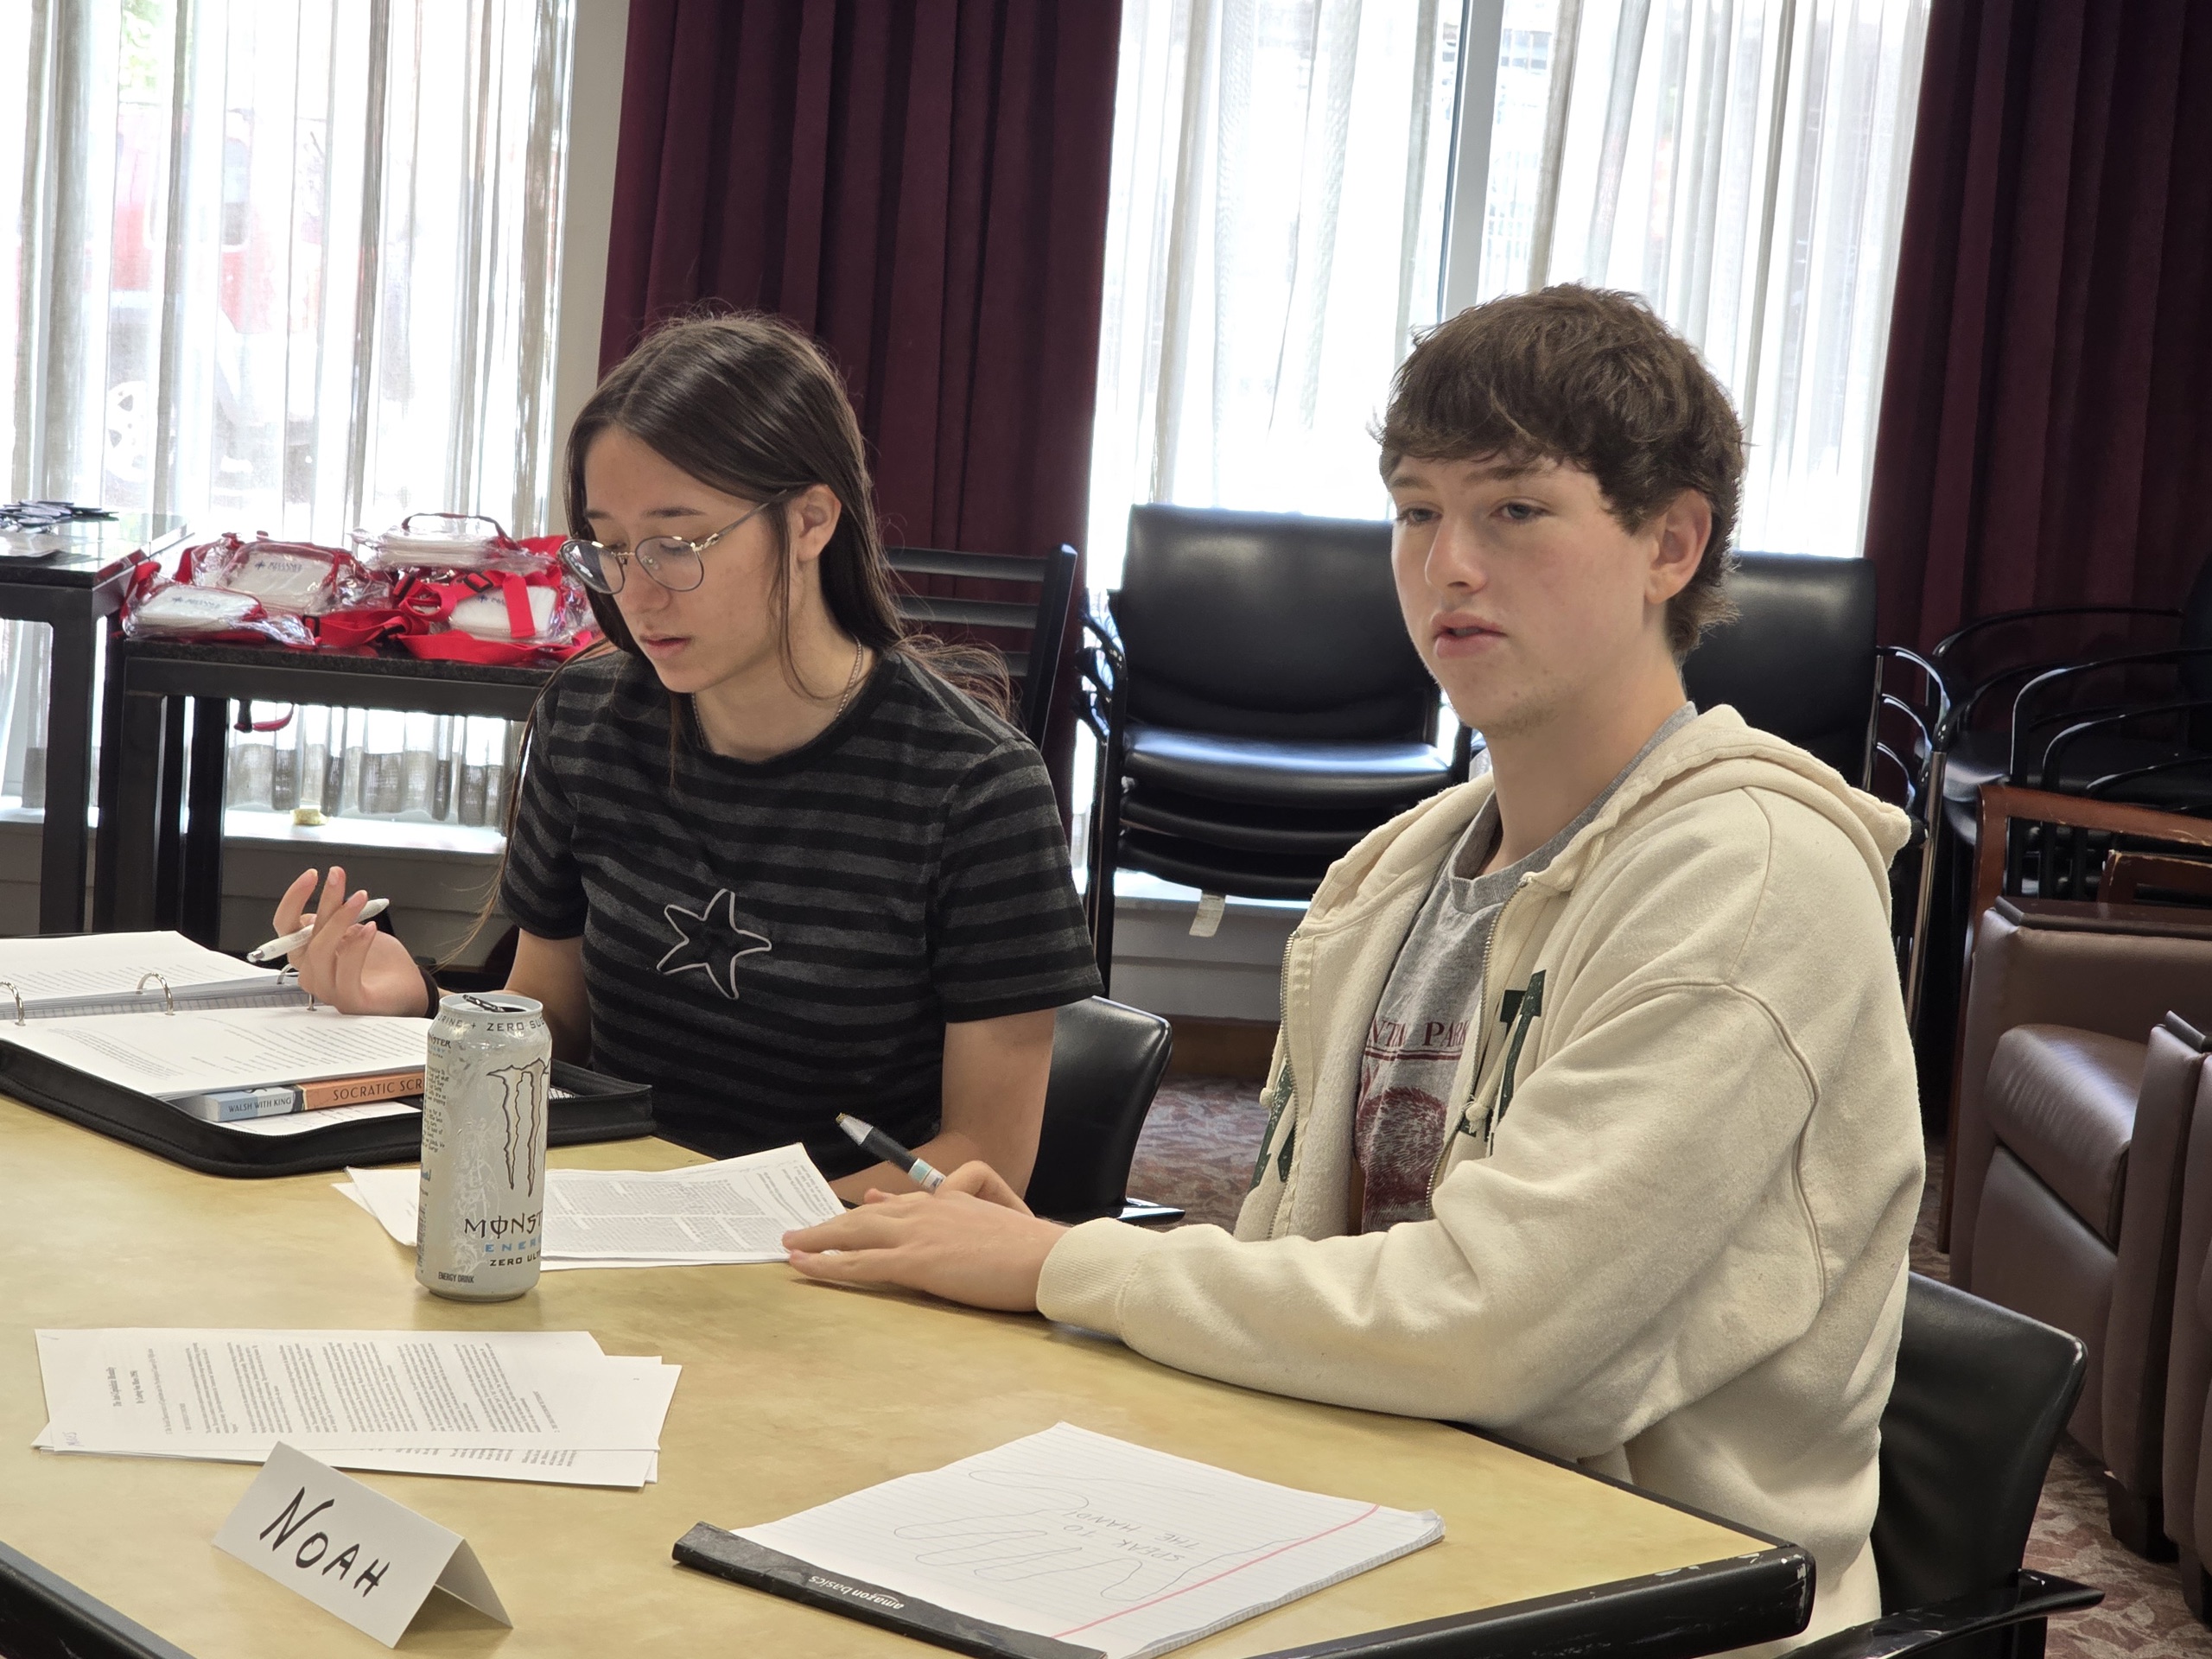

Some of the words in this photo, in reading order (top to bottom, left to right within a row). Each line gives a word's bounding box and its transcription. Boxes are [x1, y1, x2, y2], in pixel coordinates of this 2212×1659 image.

[486, 1022, 524, 1032] ZERO
[1421, 1020, 1470, 1047] PARK
[333, 1081, 396, 1102] SOCRATIC
[399, 1077, 423, 1092] SCR
[228, 1103, 252, 1114] WALSH
[253, 1100, 272, 1111] WITH
[273, 1096, 292, 1108] KING
[489, 1256, 523, 1267] ZERO
[438, 1271, 456, 1282] ENERGY
[457, 1274, 474, 1284] DRINK
[1063, 1524, 1096, 1539] TO
[1154, 1531, 1200, 1550] THE
[259, 1486, 391, 1598] NOAH
[1114, 1538, 1186, 1562] SPEAK
[808, 1575, 854, 1595] basics
[851, 1588, 905, 1610] amazon
